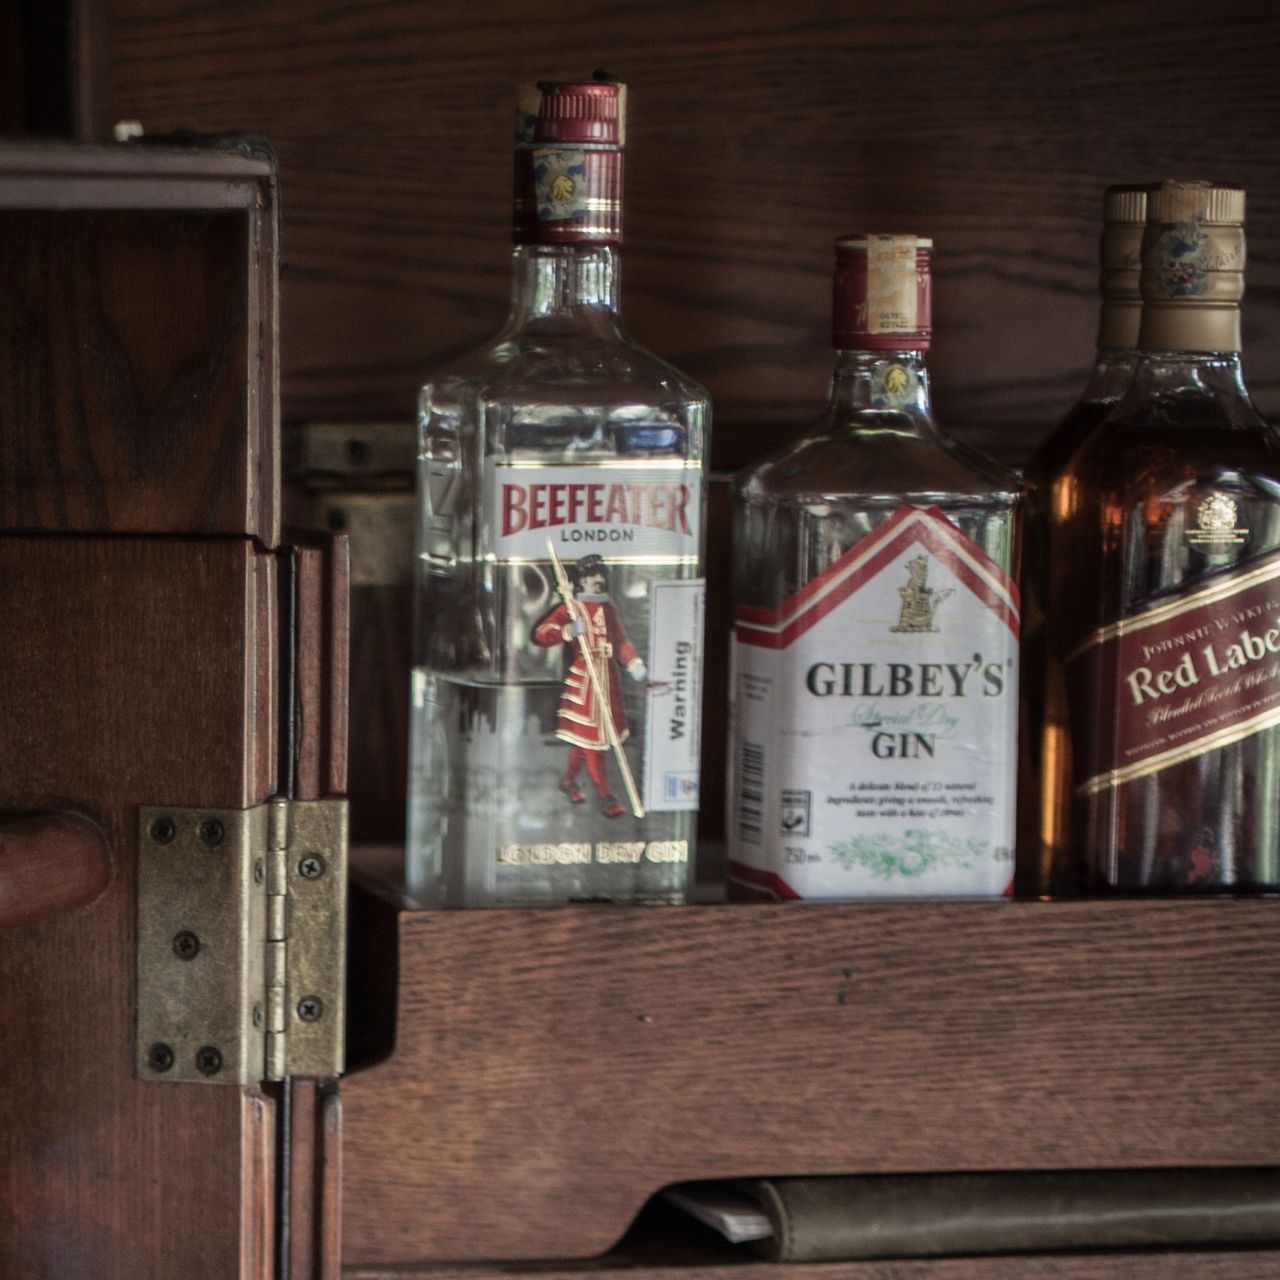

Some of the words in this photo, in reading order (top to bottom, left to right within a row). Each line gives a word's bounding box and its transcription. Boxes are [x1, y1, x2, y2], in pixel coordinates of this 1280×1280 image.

[501, 483, 694, 538] BEEFEATER
[560, 529, 635, 543] LONDON
[806, 653, 1004, 697] GILBEY'S
[1126, 651, 1200, 705] Red
[1202, 616, 1280, 677] Labe
[670, 640, 693, 741] Warning
[871, 733, 936, 759] GIN
[496, 842, 592, 865] LONDON
[595, 841, 646, 864] DRY
[645, 839, 688, 864] GIN
